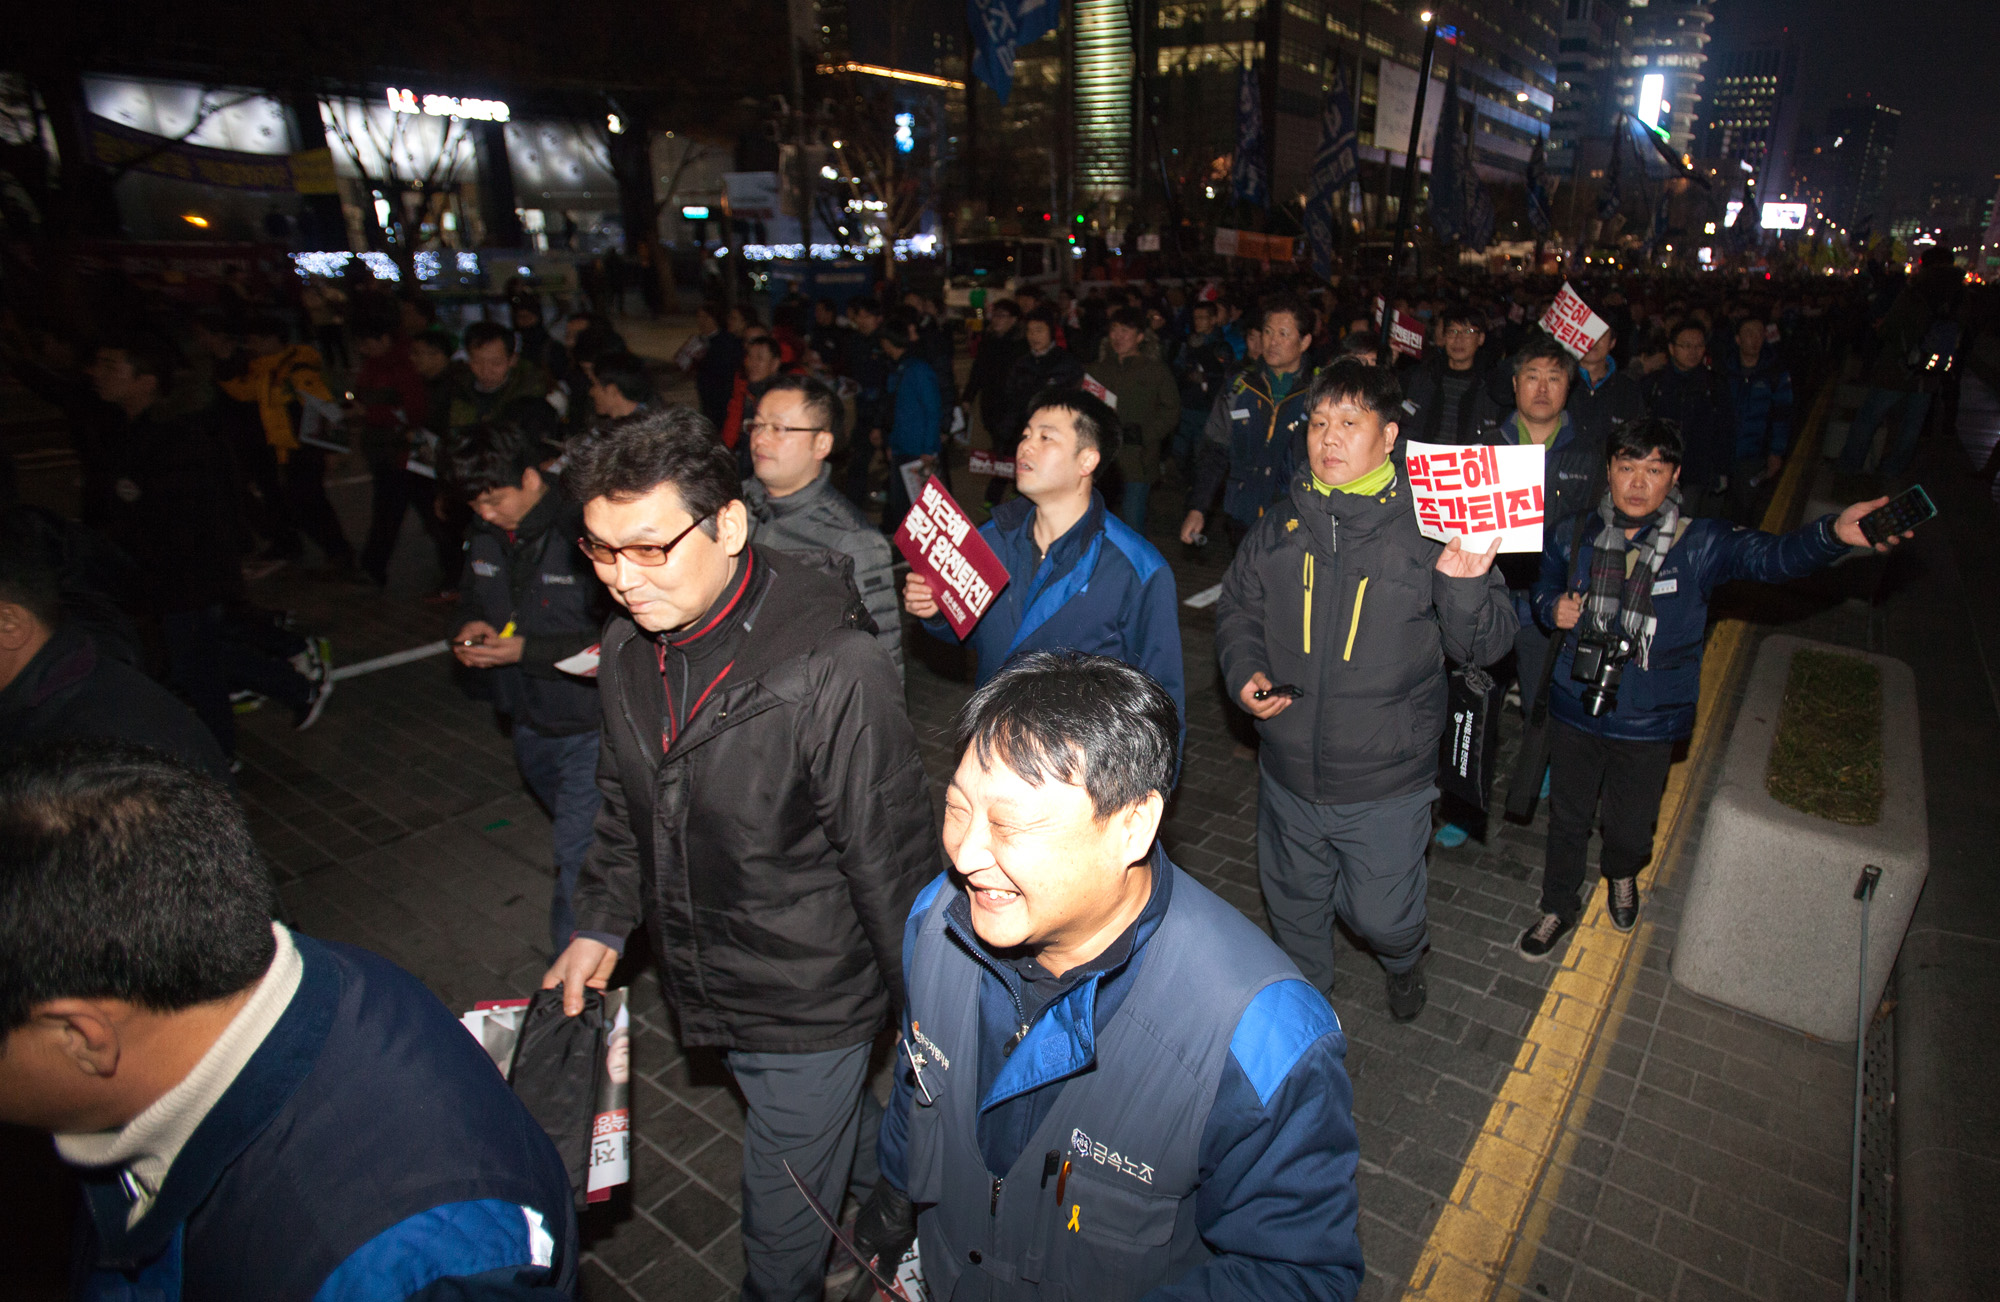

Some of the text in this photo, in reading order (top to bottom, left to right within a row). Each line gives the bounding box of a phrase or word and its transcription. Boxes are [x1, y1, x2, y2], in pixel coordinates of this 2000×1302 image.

[1553, 290, 1593, 327] 박근혜
[1406, 445, 1501, 492] 박근혜
[922, 483, 971, 547] 박근혜
[1416, 485, 1545, 535] 즉각퇴진
[905, 504, 938, 555] 즉각
[928, 535, 993, 618] 완전퇴진!
[1093, 1141, 1155, 1185] 금속노조
